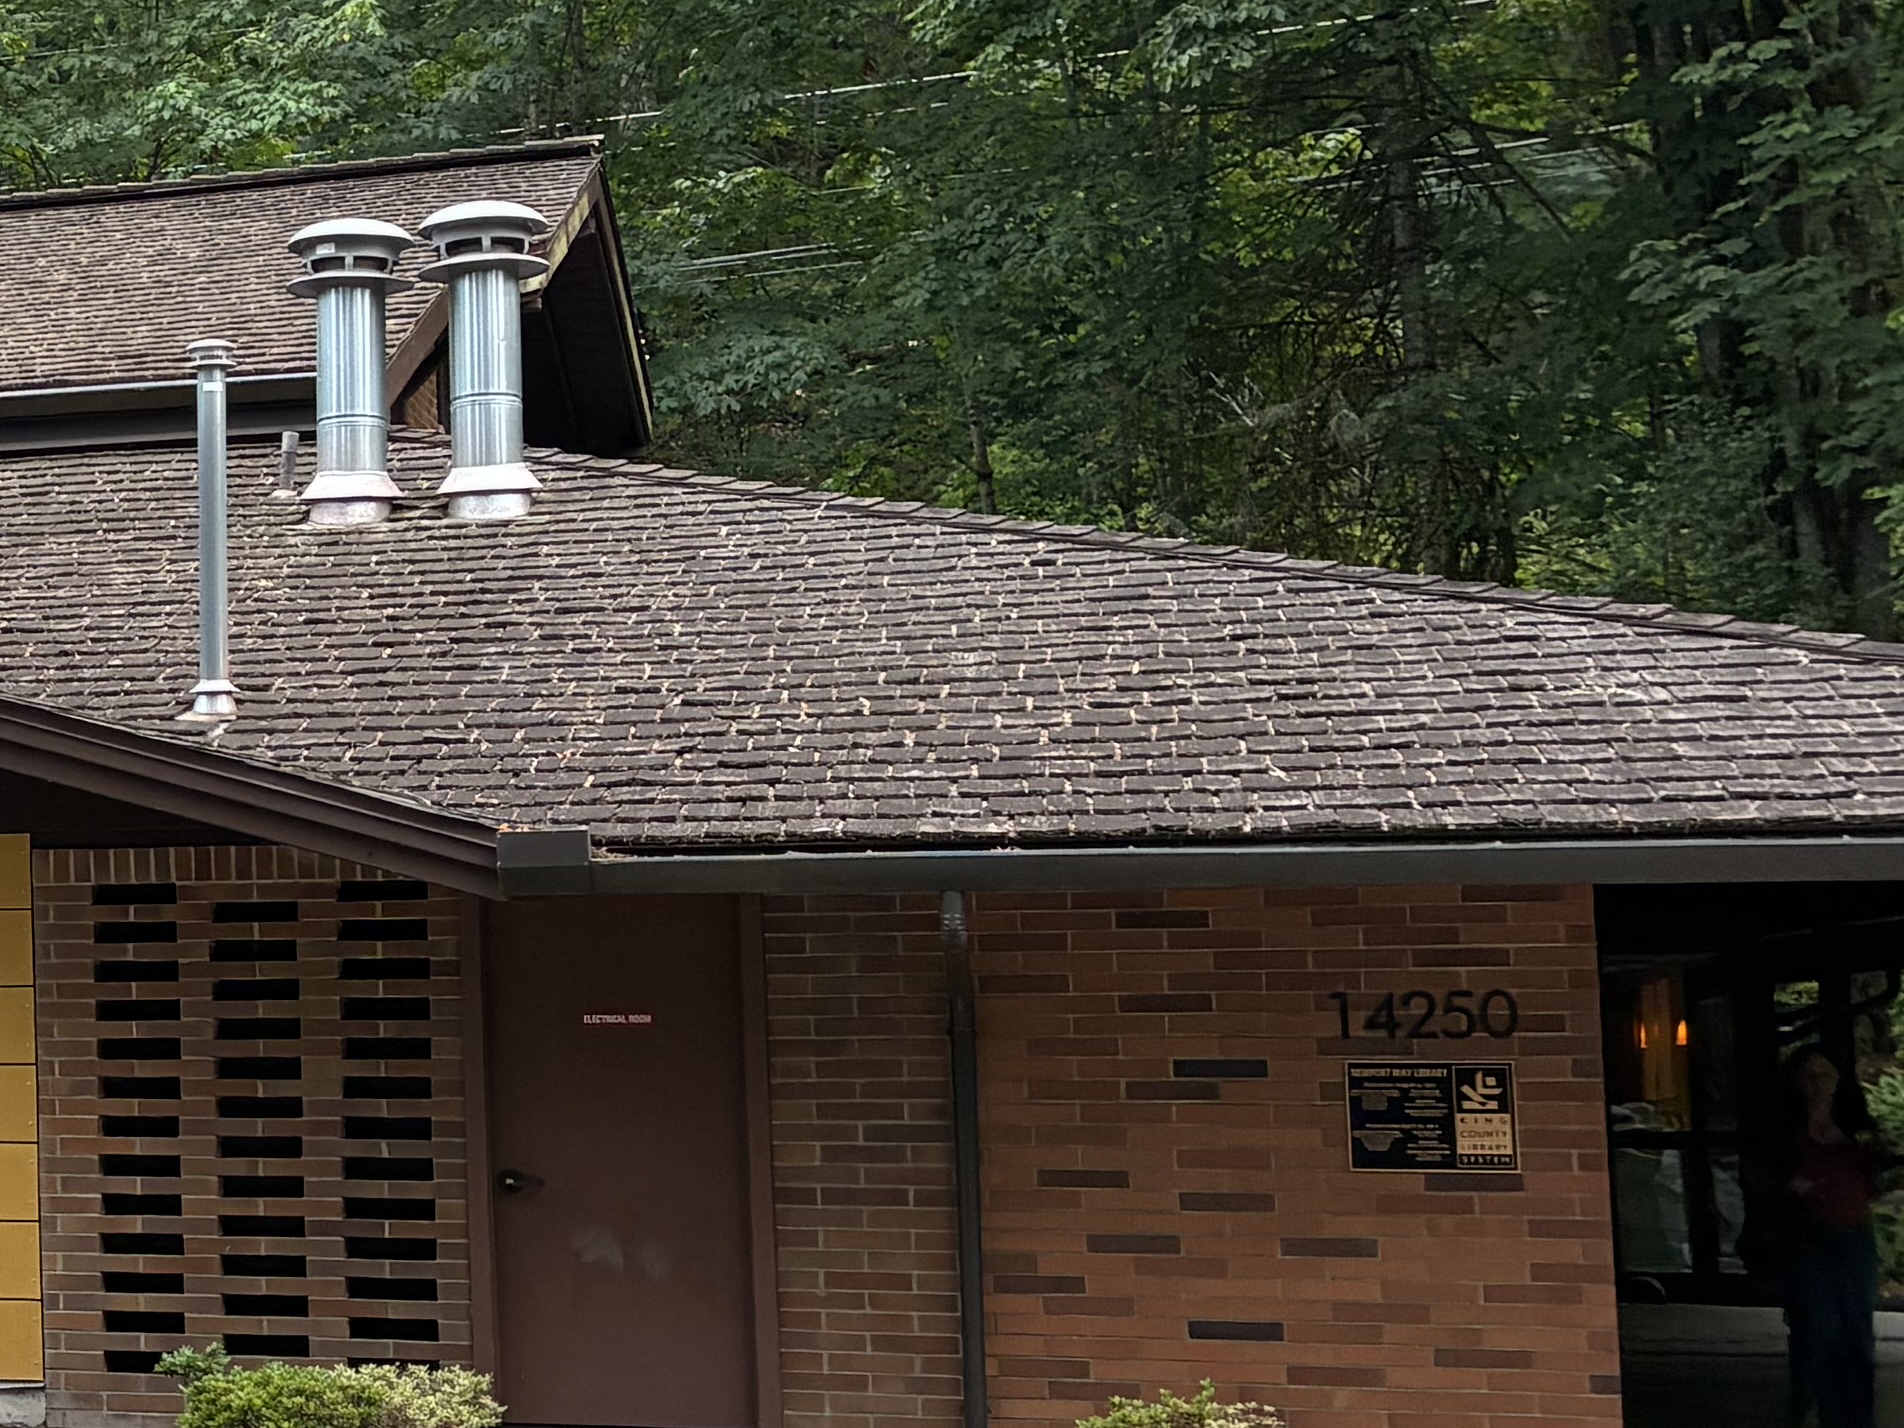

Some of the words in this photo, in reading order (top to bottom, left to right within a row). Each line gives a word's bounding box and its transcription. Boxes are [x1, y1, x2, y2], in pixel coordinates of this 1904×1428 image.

[1328, 988, 1519, 1040] 14250
[583, 1014, 628, 1024] ELECTRICAL
[1459, 1130, 1507, 1138] COUNTY
[1460, 1143, 1508, 1151] LIBRARY
[1461, 1156, 1511, 1165] SYSTEM
